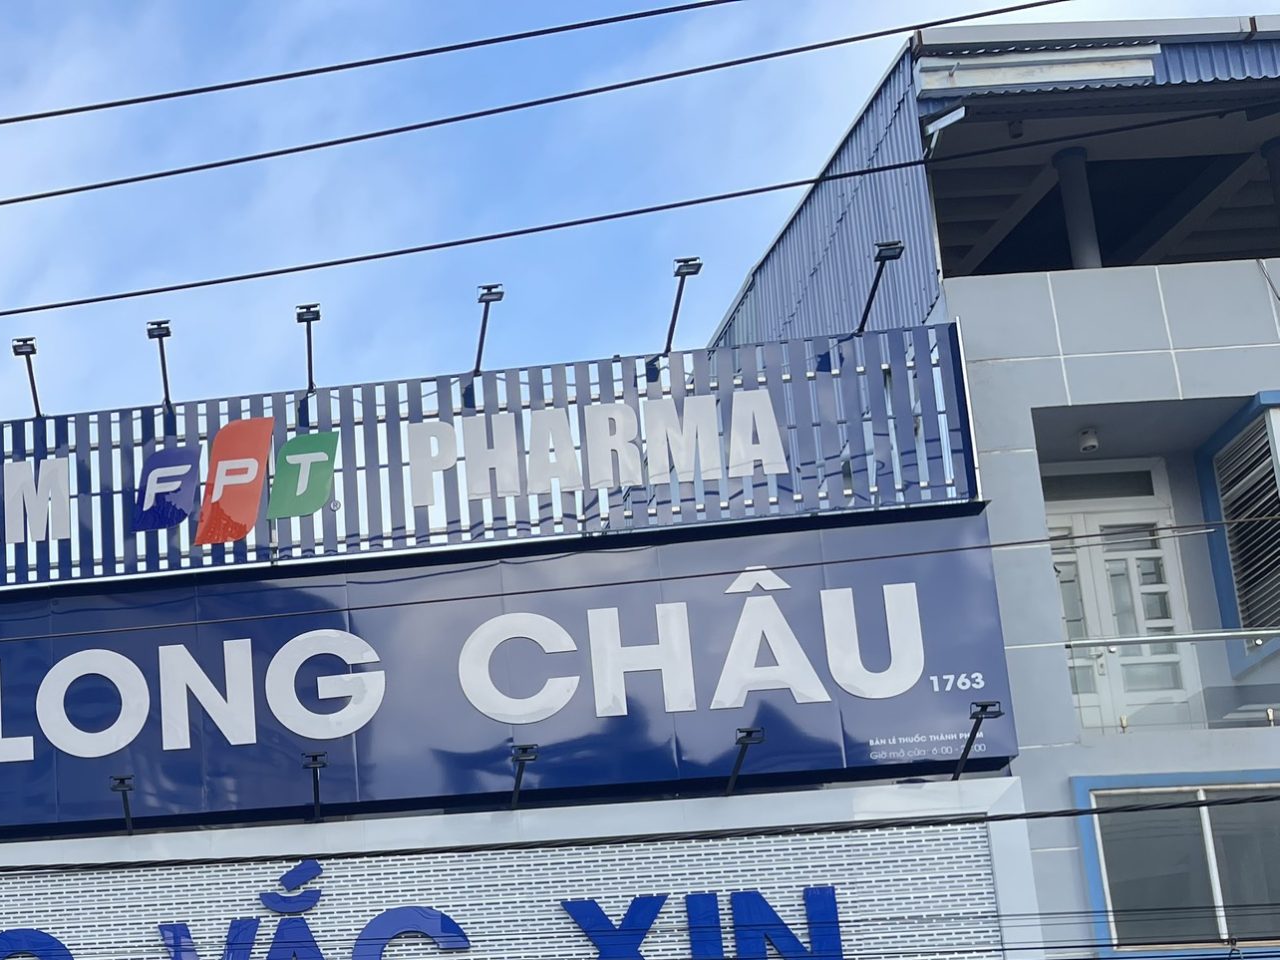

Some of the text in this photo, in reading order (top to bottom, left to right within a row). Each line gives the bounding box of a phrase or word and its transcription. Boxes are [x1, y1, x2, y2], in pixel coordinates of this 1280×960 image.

[405, 388, 790, 507] PHARMA
[457, 565, 927, 725] CHÂU
[928, 672, 986, 693] 1763
[959, 731, 984, 741] PHM
